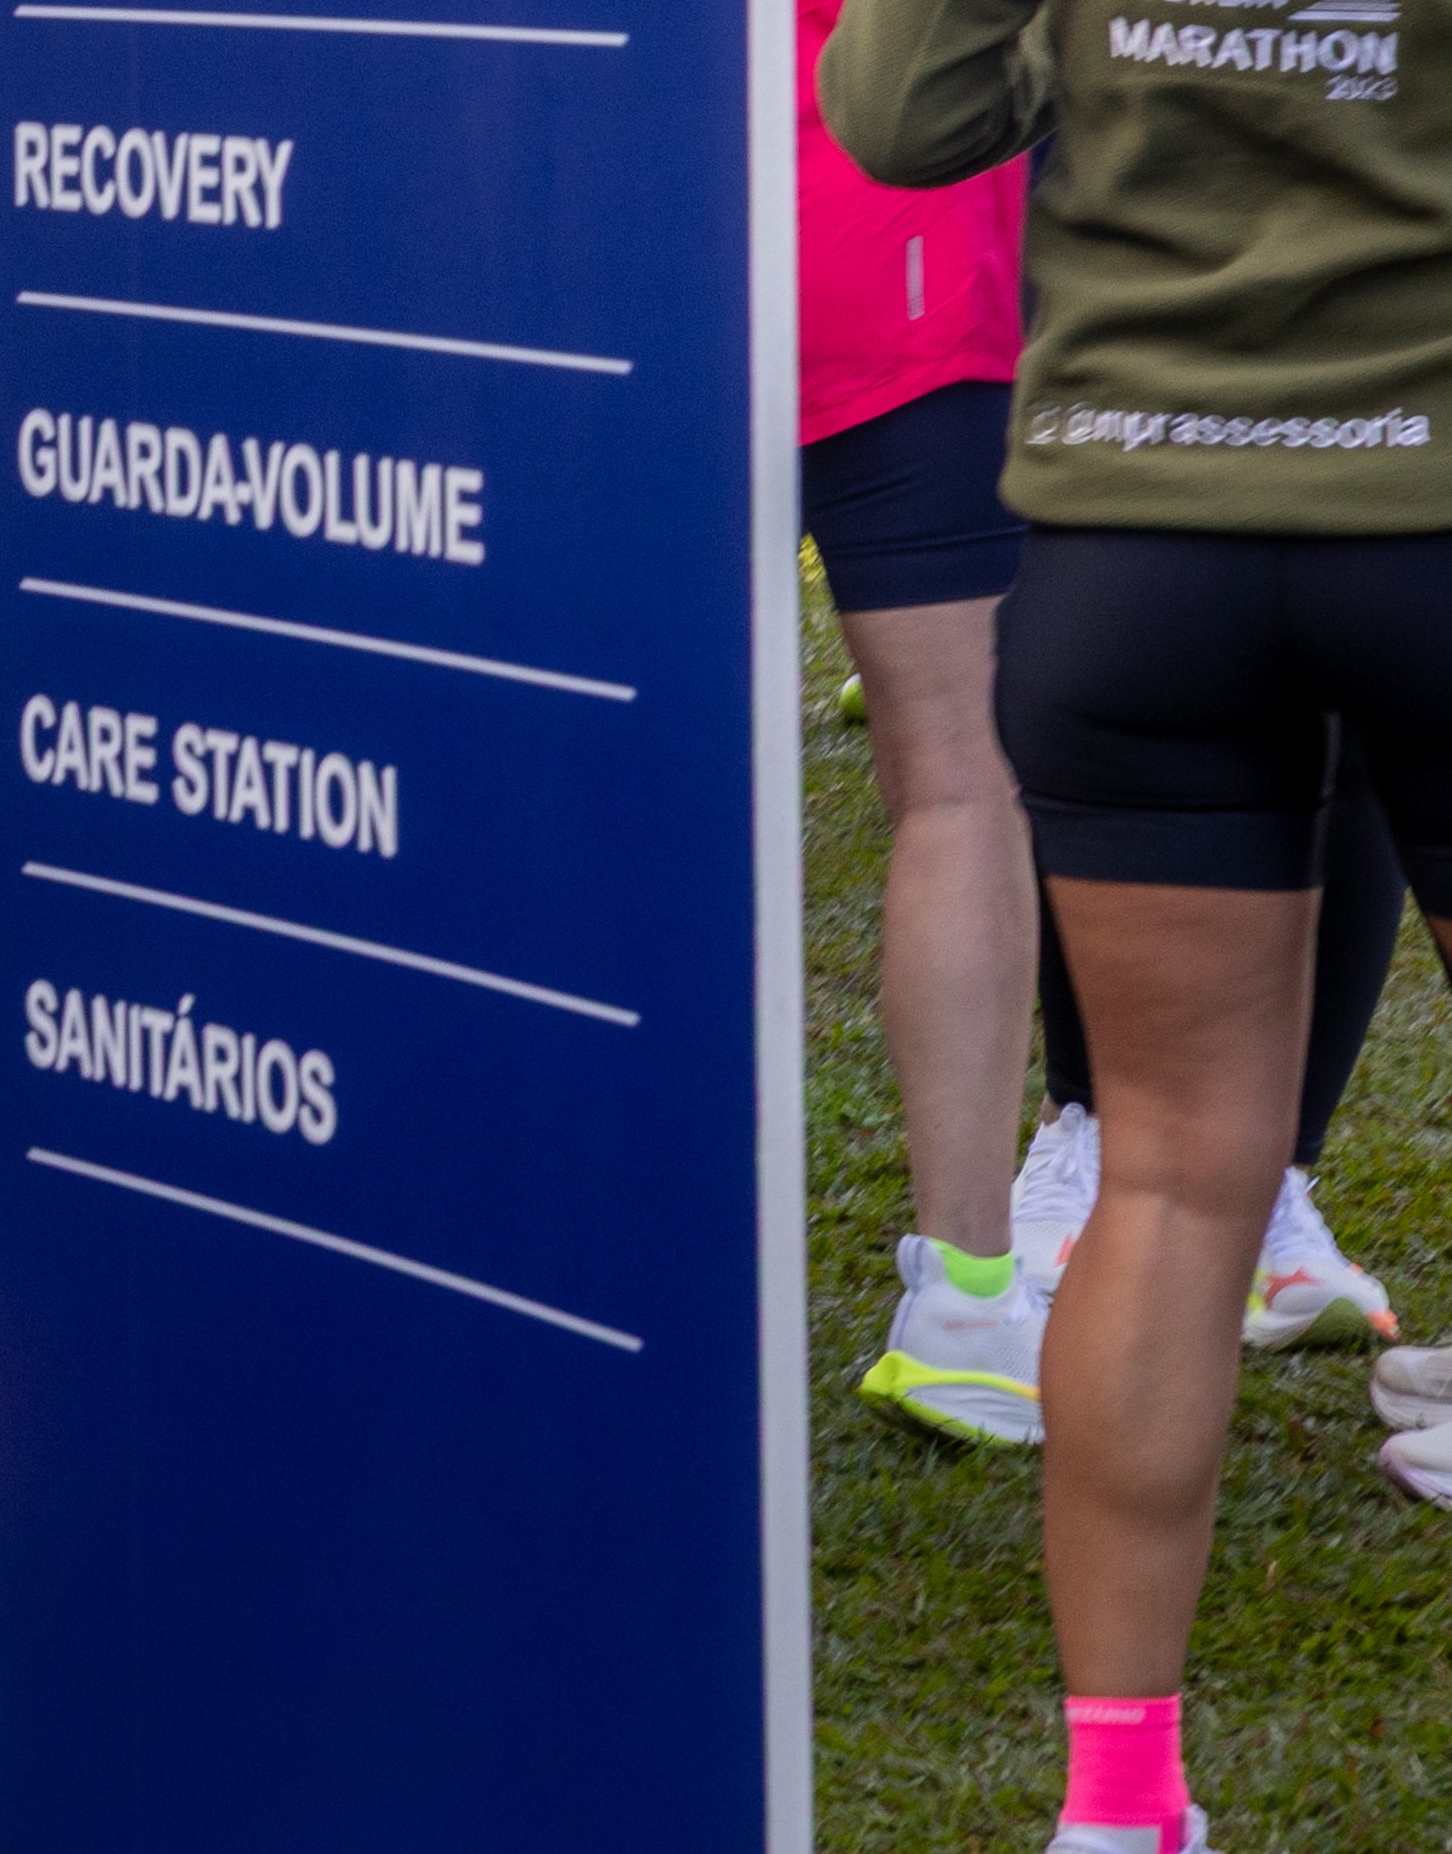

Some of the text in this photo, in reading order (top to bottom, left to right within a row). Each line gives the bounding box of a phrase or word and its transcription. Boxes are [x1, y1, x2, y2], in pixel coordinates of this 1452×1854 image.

[1107, 14, 1400, 76] MARATHON
[14, 121, 294, 229] RECOVERY
[18, 407, 486, 566] GUARDA-VOLUME
[20, 693, 399, 859] CARE STATION
[24, 979, 338, 1146] SANITÁRIOS
